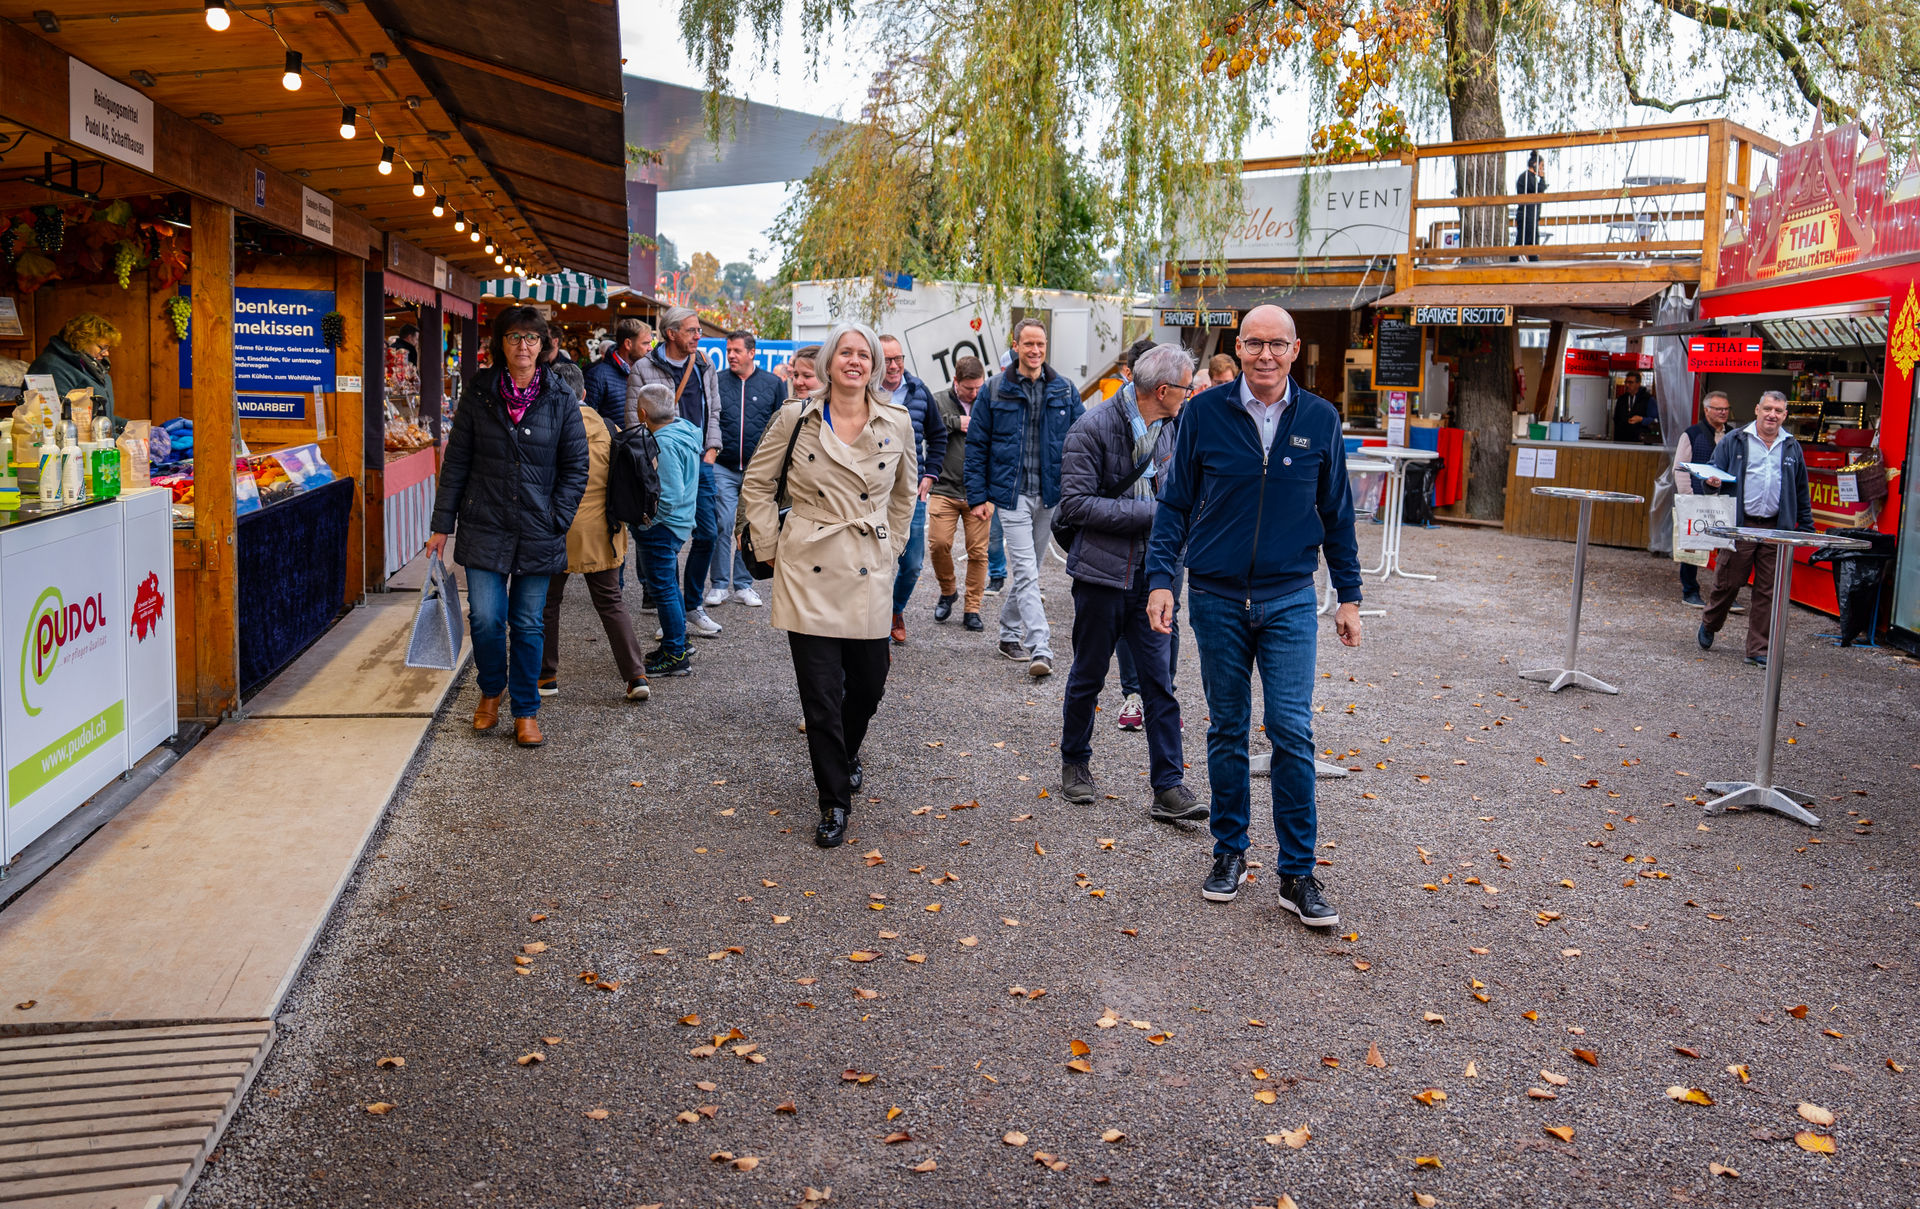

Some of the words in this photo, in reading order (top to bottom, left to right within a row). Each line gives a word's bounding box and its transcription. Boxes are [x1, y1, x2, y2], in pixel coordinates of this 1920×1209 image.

[94, 88, 139, 124] Reinigungsmittel
[85, 115, 101, 138] Pudol
[111, 127, 144, 156] Schaffhausen
[257, 179, 265, 200] 19
[1327, 187, 1402, 212] EVENT
[1789, 220, 1826, 251] THAI
[1776, 249, 1836, 273] SPEZIALITÄTEN
[1462, 308, 1505, 323] RISOTTO
[1577, 352, 1599, 360] THAI
[1707, 342, 1743, 352] THAI
[292, 357, 322, 365] unterwegs
[1690, 357, 1759, 368] Spezialitäten
[41, 718, 107, 773] www.pudol.ch
